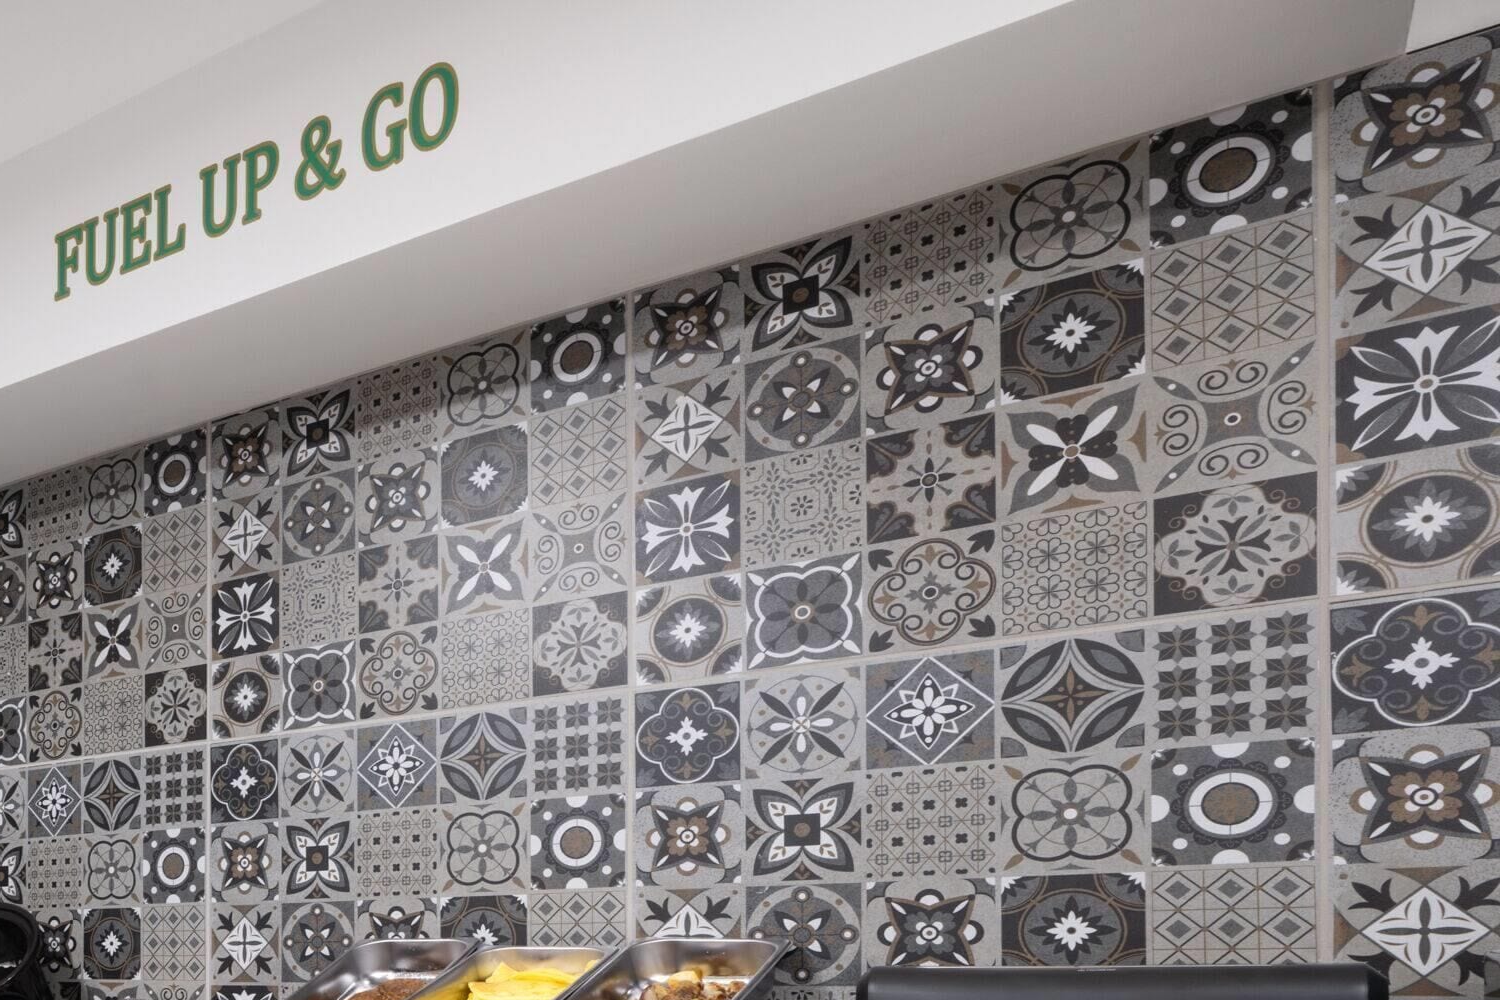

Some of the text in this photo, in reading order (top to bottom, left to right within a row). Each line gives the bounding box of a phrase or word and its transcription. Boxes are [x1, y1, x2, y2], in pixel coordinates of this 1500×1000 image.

[54, 61, 459, 302] FUEL UP & GO
